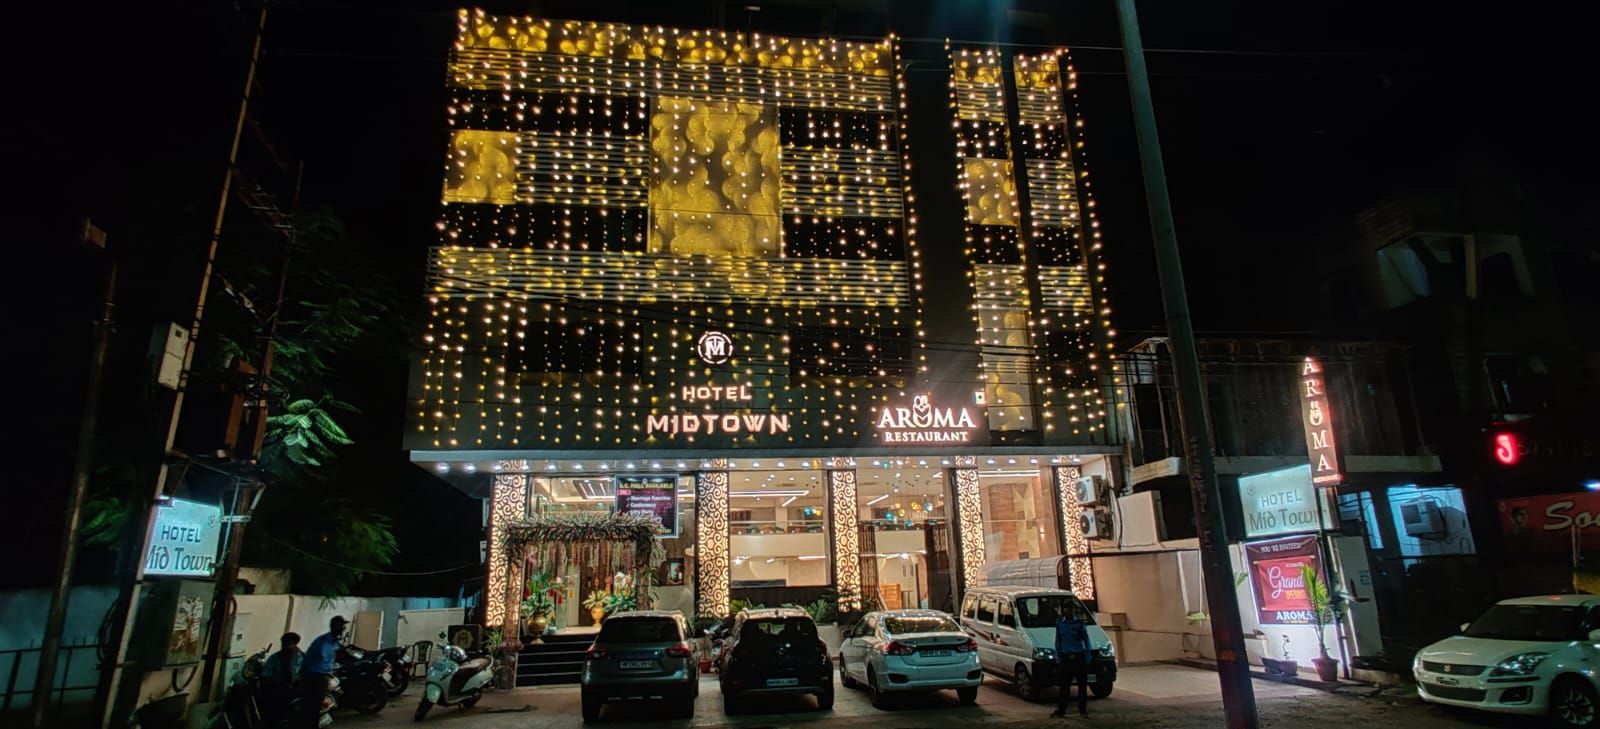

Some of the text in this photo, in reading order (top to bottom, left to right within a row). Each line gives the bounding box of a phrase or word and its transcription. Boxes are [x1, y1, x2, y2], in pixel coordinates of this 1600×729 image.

[682, 385, 752, 401] HOTEL
[878, 395, 976, 428] AROMA
[1302, 357, 1334, 472] AROMA
[646, 414, 788, 434] MIDTOWN
[885, 431, 968, 442] RESTAURANT
[1260, 489, 1302, 507] HOTEL
[1249, 511, 1276, 531] Mid
[161, 524, 202, 543] HOTEL
[1267, 565, 1305, 599] Grand
